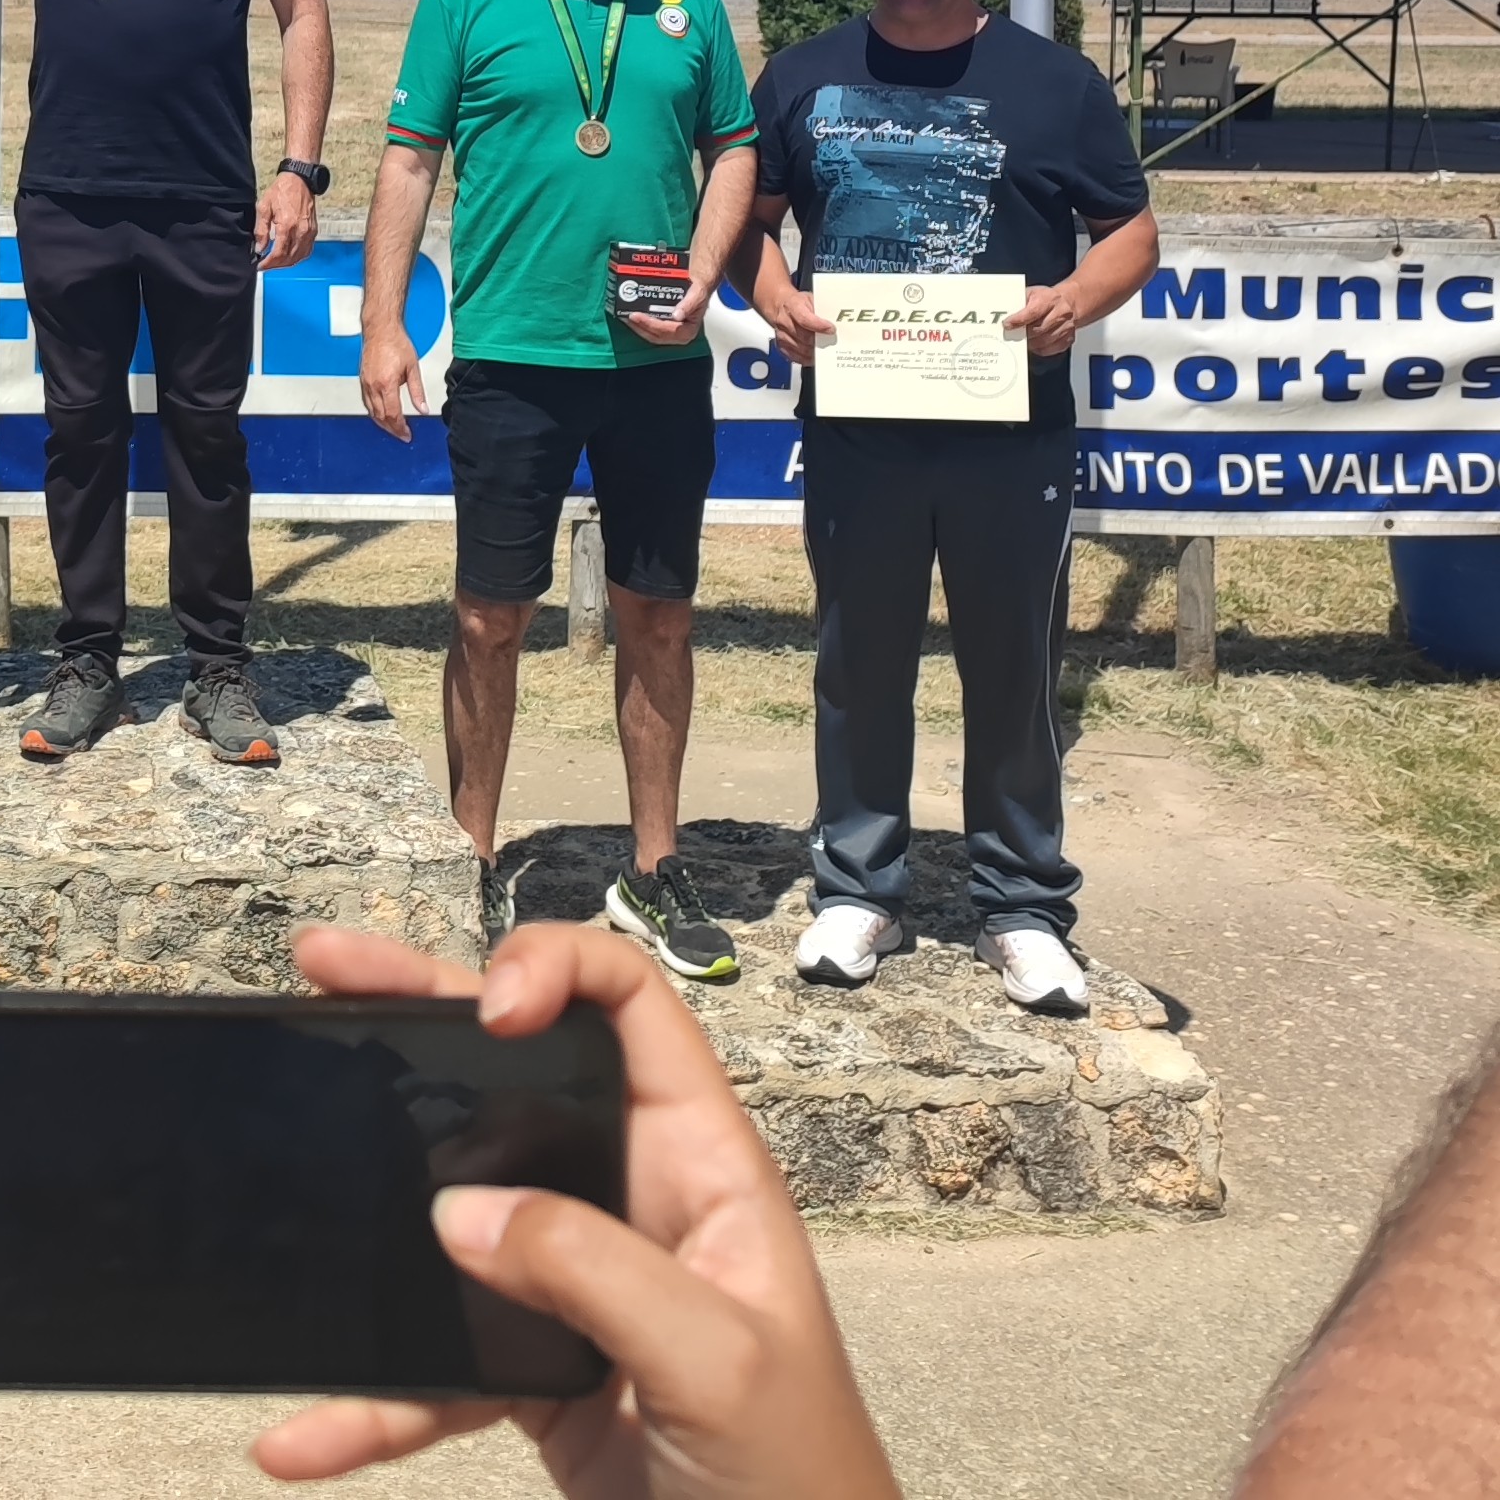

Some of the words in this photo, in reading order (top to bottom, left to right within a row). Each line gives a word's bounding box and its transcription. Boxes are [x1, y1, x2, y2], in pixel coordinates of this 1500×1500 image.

[1142, 264, 1494, 323] Munic
[881, 328, 953, 342] DIPLOMA
[1218, 453, 1284, 496] DE
[1298, 452, 1500, 495] VALLAD
